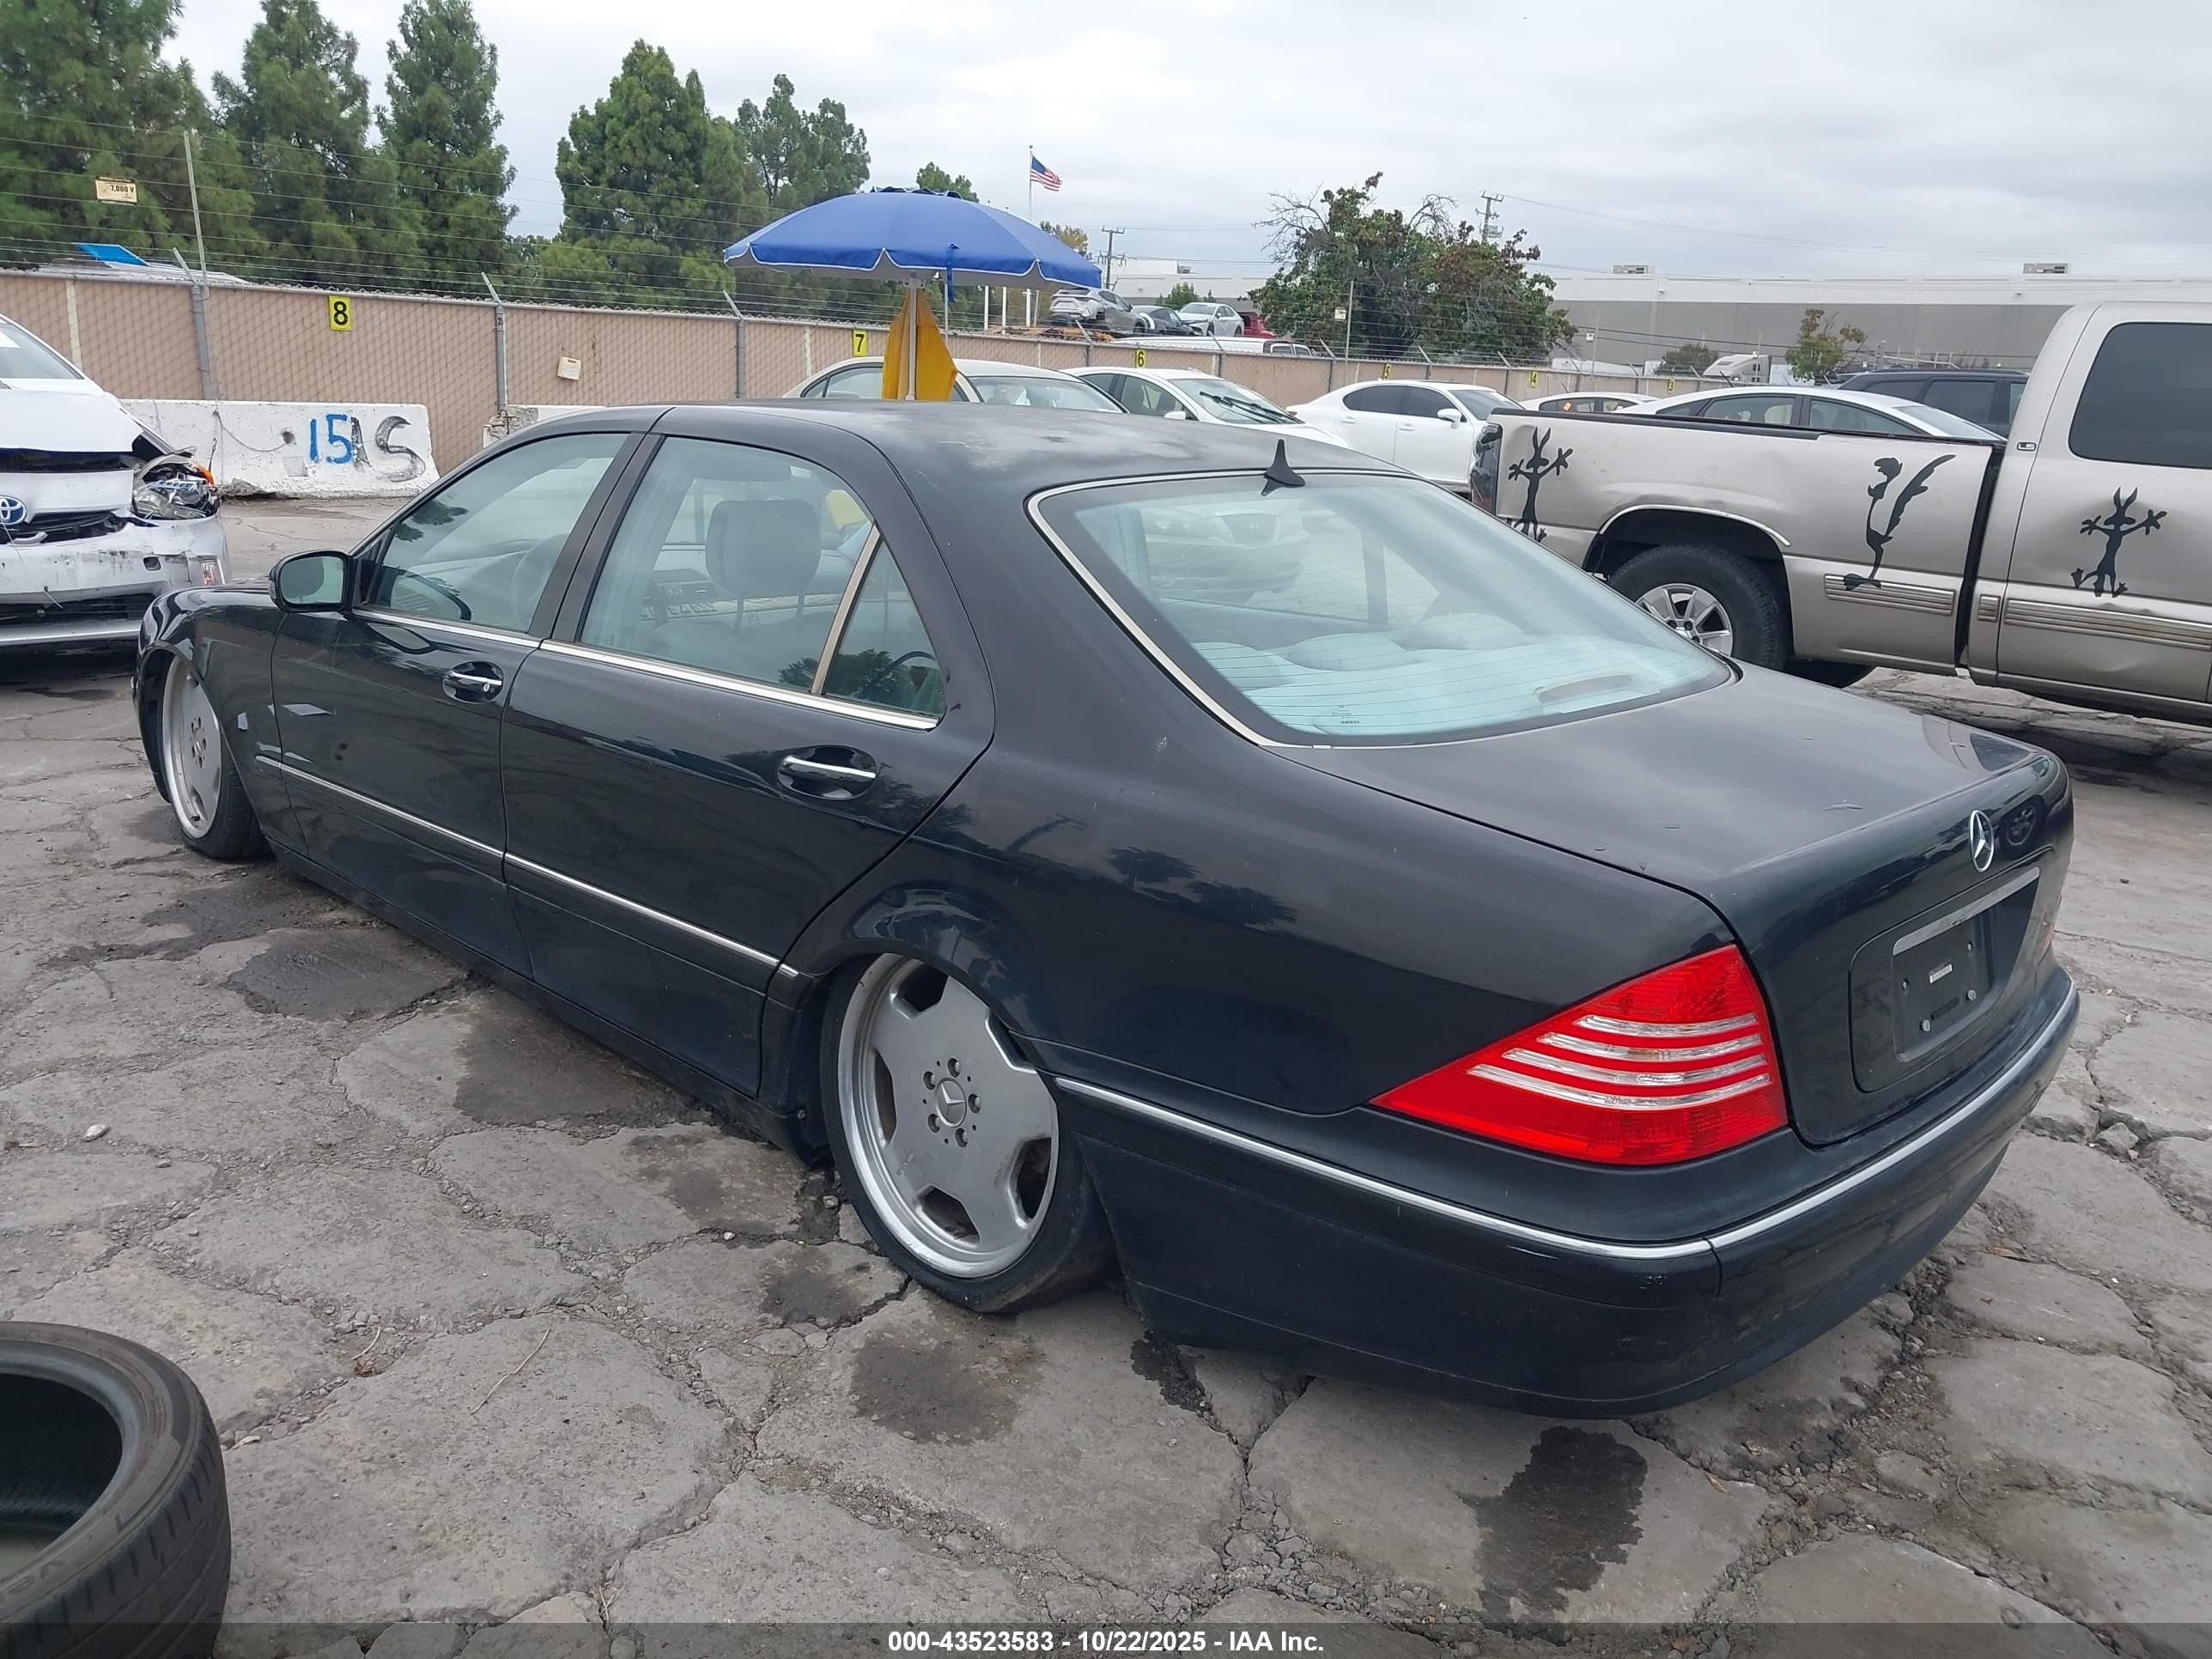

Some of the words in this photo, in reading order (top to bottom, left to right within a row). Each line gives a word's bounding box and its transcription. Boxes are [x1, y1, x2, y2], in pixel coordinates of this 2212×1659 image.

[333, 301, 349, 325] 8
[855, 333, 865, 353] 7
[1138, 350, 1145, 368] 6
[1384, 365, 1390, 380] 5
[1532, 373, 1537, 386] 4
